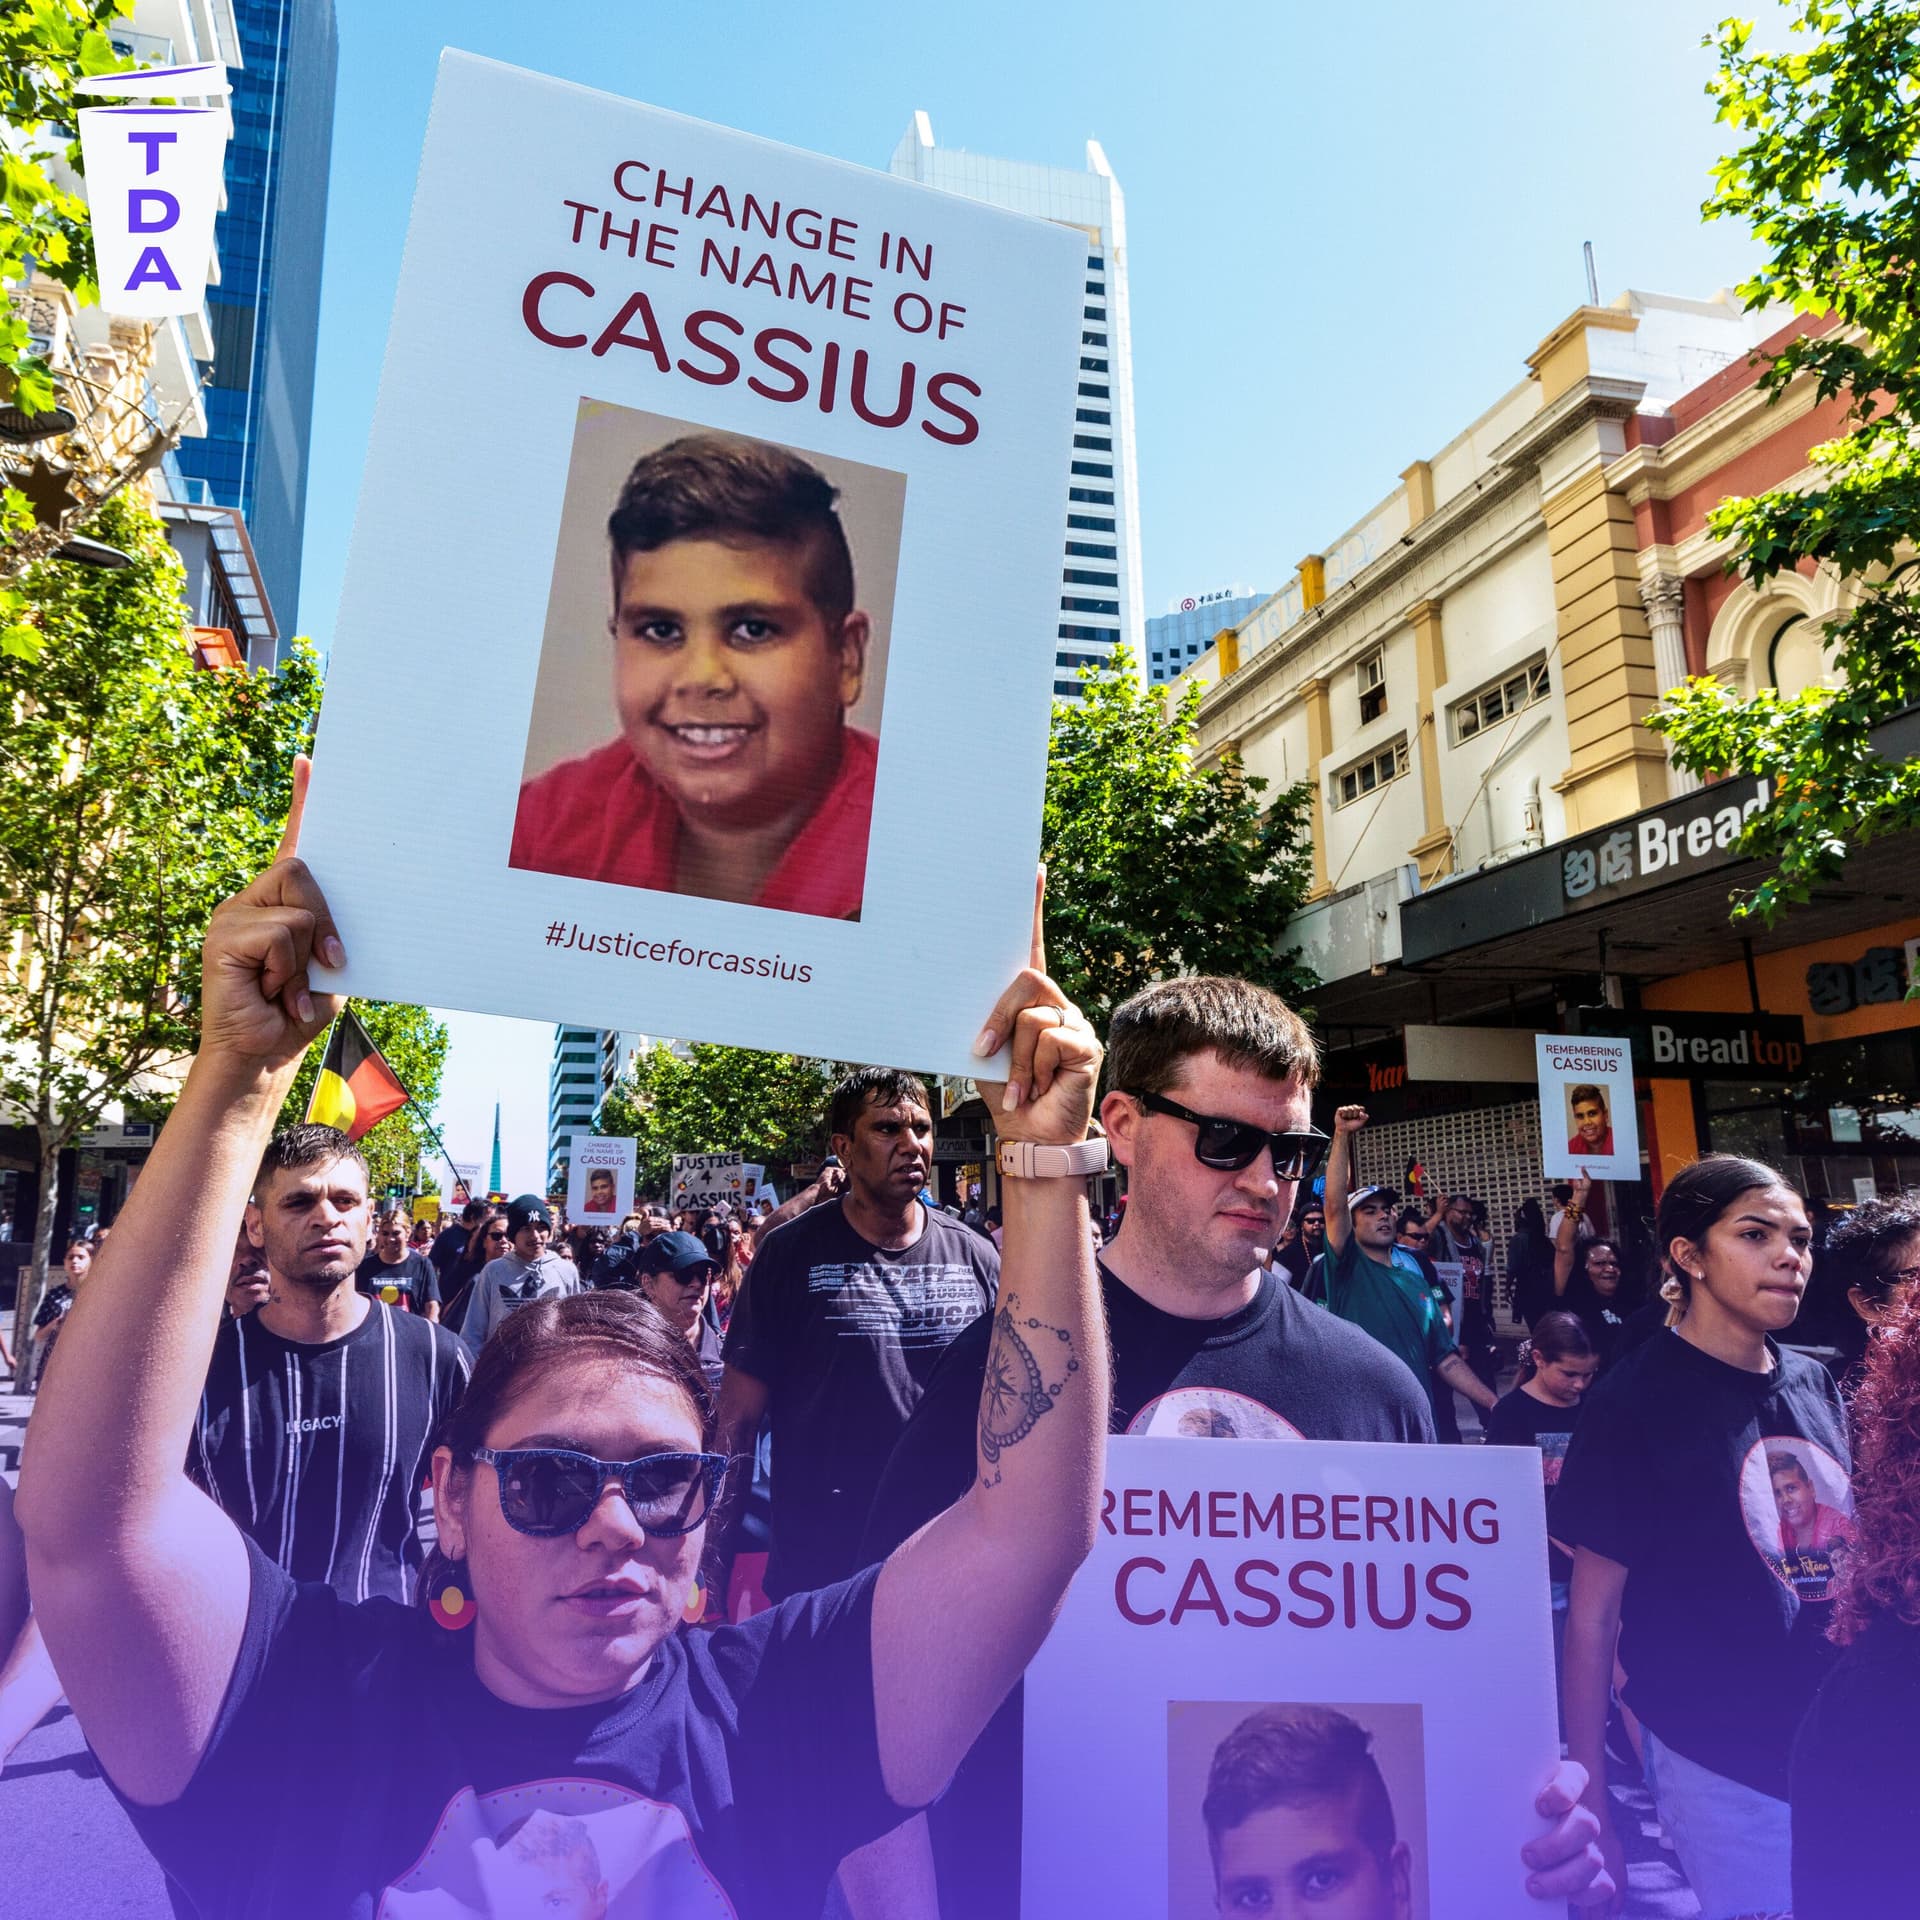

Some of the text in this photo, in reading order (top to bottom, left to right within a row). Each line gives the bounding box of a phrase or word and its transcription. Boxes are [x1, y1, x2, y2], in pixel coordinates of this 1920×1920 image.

[613, 160, 933, 281] CHANGE IN
[563, 200, 967, 340] THE NAME OF
[521, 271, 982, 445] CASSIUS
[545, 920, 813, 983] #Justiceforcassius
[1545, 1044, 1623, 1057] REMEMBERING
[1553, 1057, 1618, 1072] CASSIUS
[580, 1155, 626, 1165] CASSIUS
[674, 1153, 740, 1172] JUSTICE
[700, 1170, 712, 1185] 4
[676, 1191, 741, 1210] CASSIUS
[286, 1416, 341, 1434] LEGACY
[1114, 1557, 1472, 1631] CASSIUS
